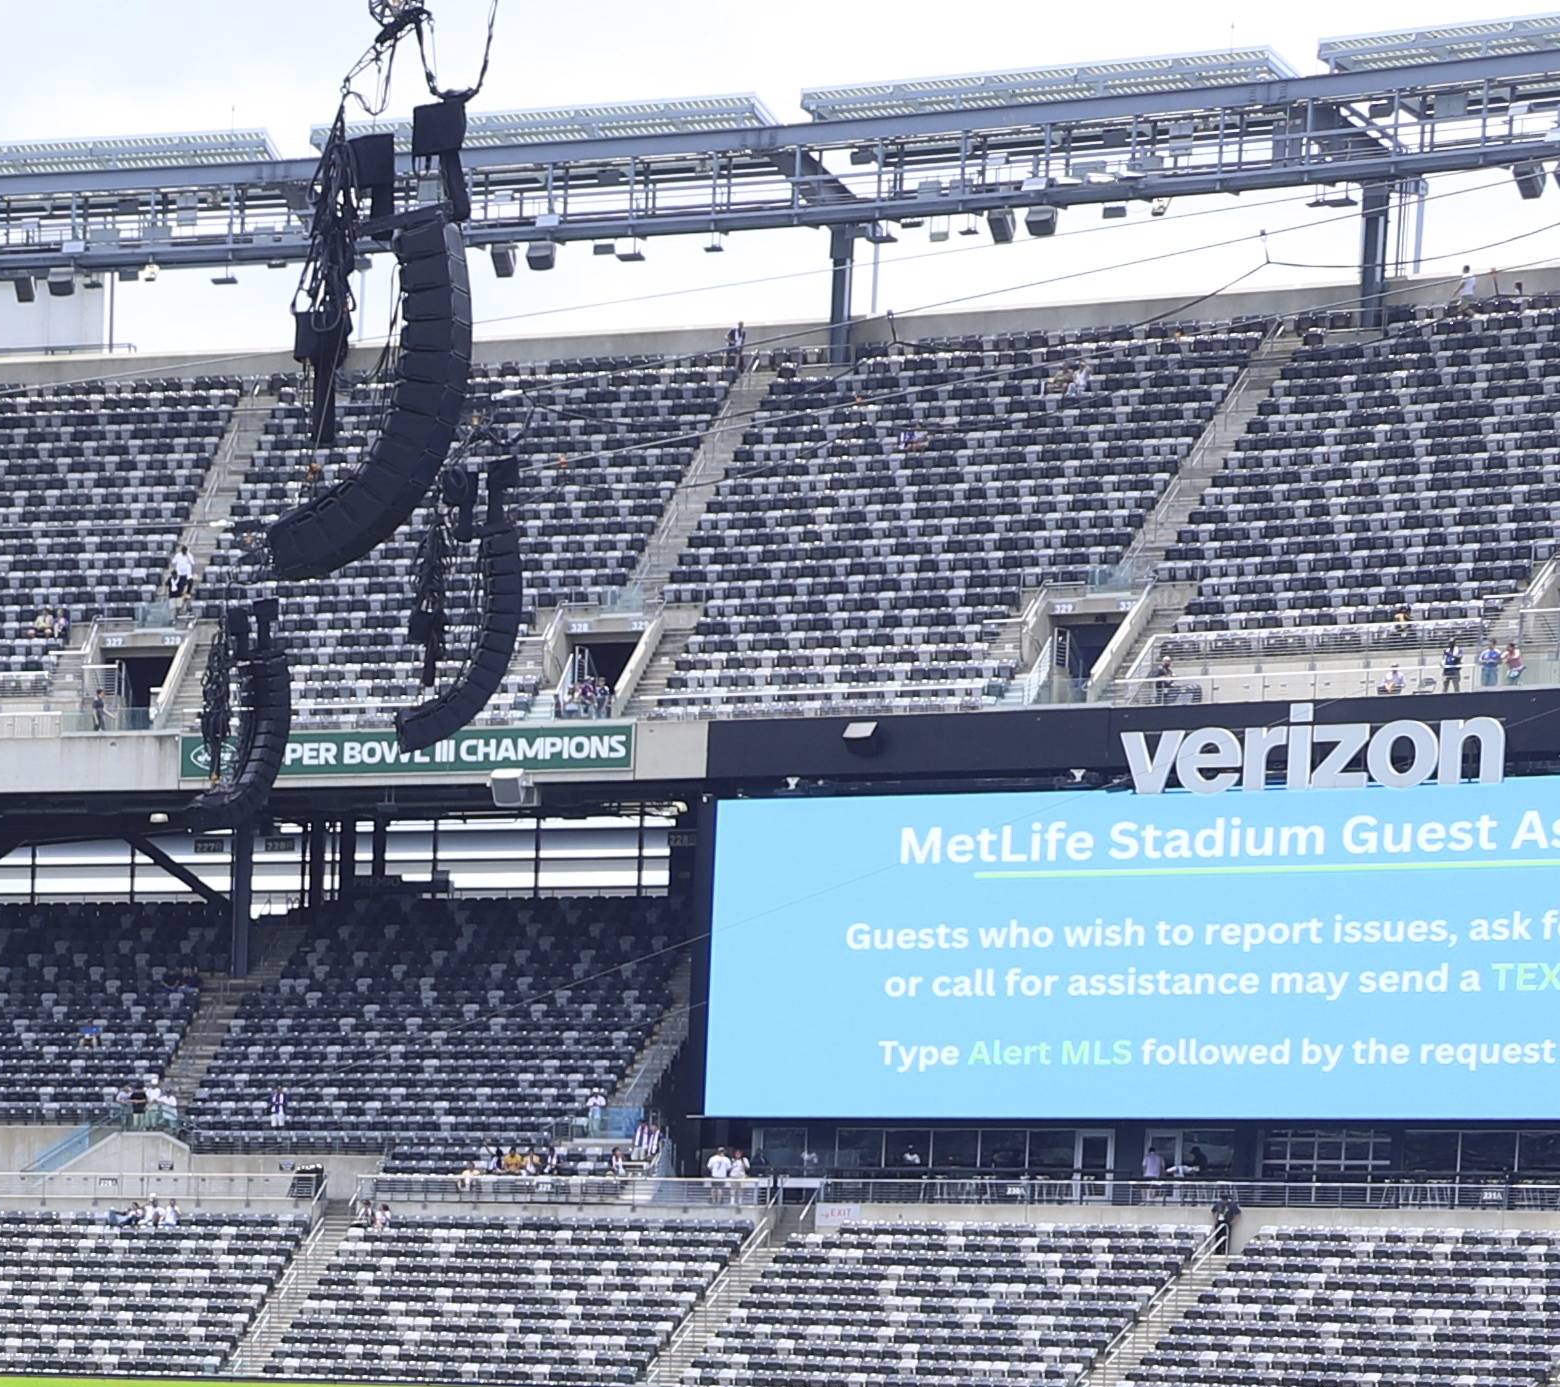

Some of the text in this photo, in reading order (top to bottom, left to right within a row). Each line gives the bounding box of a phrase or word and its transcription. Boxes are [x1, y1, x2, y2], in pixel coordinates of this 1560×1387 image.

[105, 638, 122, 647] 327
[570, 622, 588, 631] 328
[283, 742, 337, 765] PER
[435, 739, 455, 762] III
[460, 734, 627, 760] CHAMPIONS
[1120, 702, 1507, 794] verizon
[900, 815, 1499, 864] MetLife Stadium Guest
[846, 923, 970, 950] Guests
[979, 919, 1054, 948] who
[1064, 918, 1146, 948] wish
[1155, 921, 1194, 946] to
[1205, 918, 1323, 951] report
[1334, 914, 1458, 947] issues,
[1469, 911, 1532, 941] ask
[884, 976, 924, 998] or
[932, 970, 996, 997] call
[1005, 969, 1059, 997] for
[1067, 967, 1260, 996] assistance
[1271, 972, 1350, 1000] may
[1358, 963, 1449, 993] send
[1459, 970, 1482, 992] a
[879, 1038, 1557, 1072] Type Alert MLS followed by the request
